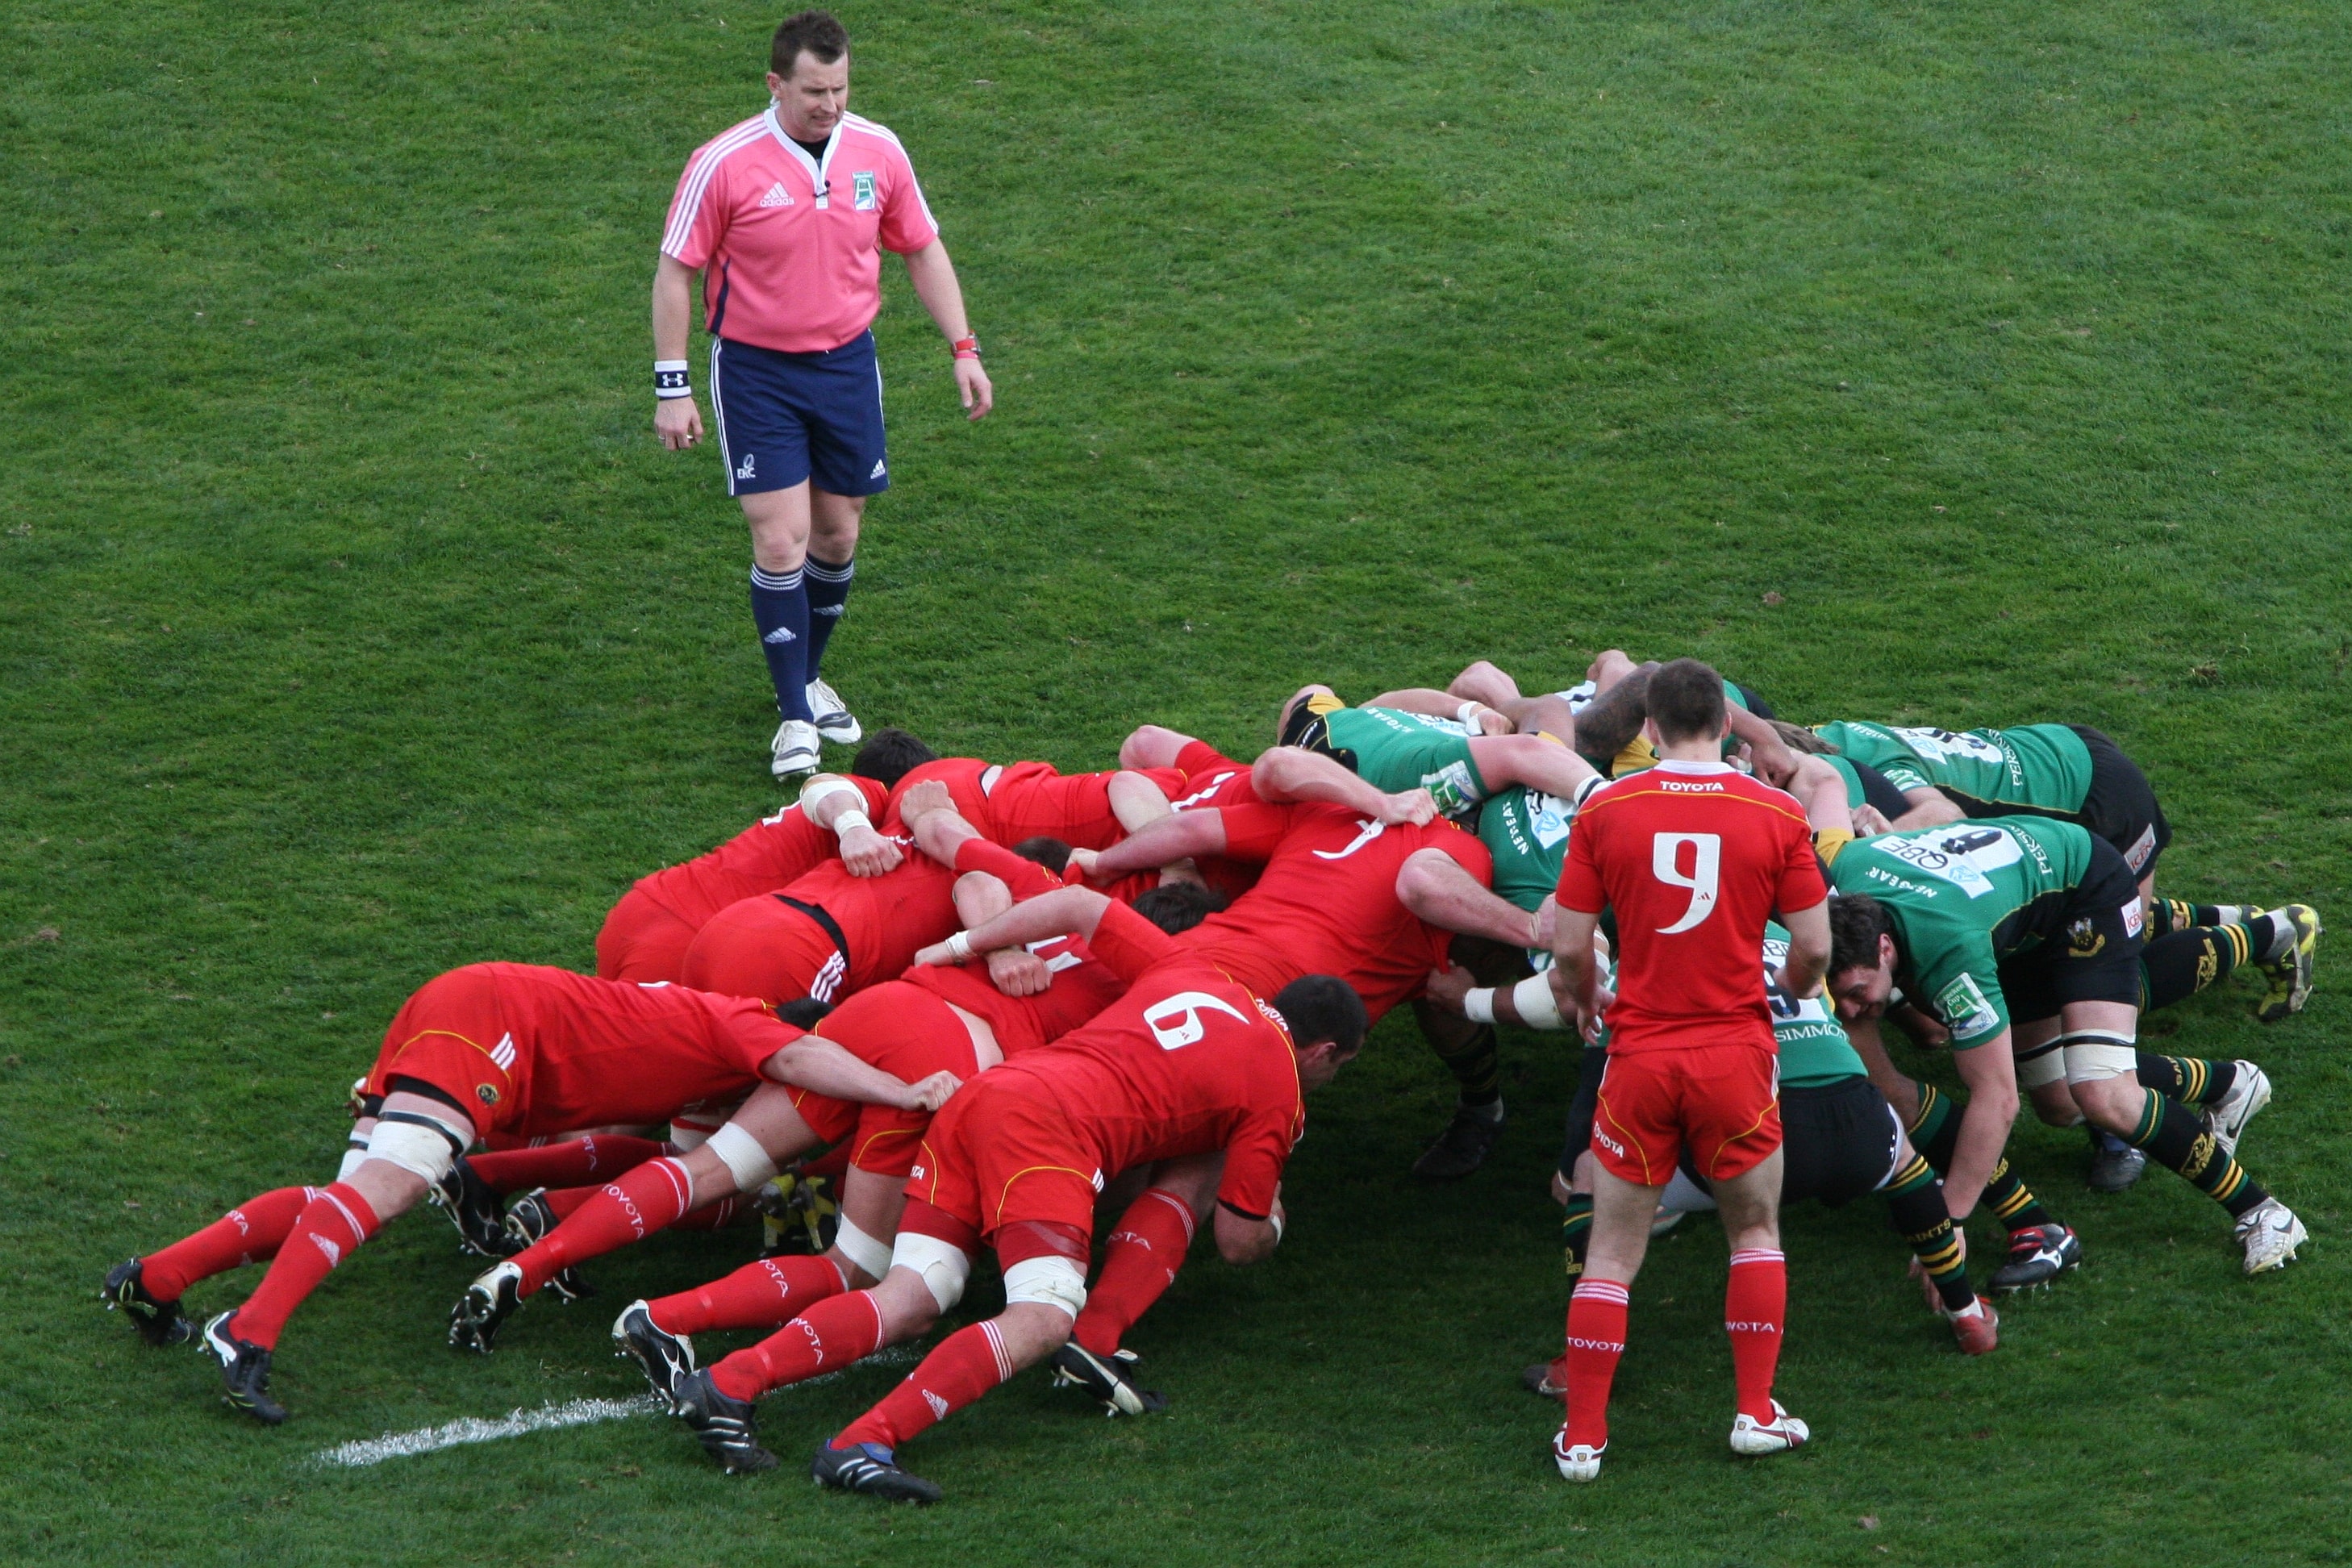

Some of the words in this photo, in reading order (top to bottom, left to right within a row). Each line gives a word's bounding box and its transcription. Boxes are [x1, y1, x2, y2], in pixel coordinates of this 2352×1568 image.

[759, 197, 795, 207] adidas
[1660, 781, 1724, 792] TOYOTA
[1883, 840, 1949, 869] QBE
[1652, 832, 1721, 934] 9
[1142, 991, 1251, 1051] 6
[1594, 1120, 1624, 1158] OYOTA
[602, 1184, 644, 1239] TOYOTA
[1567, 1337, 1624, 1352] TOYOTA
